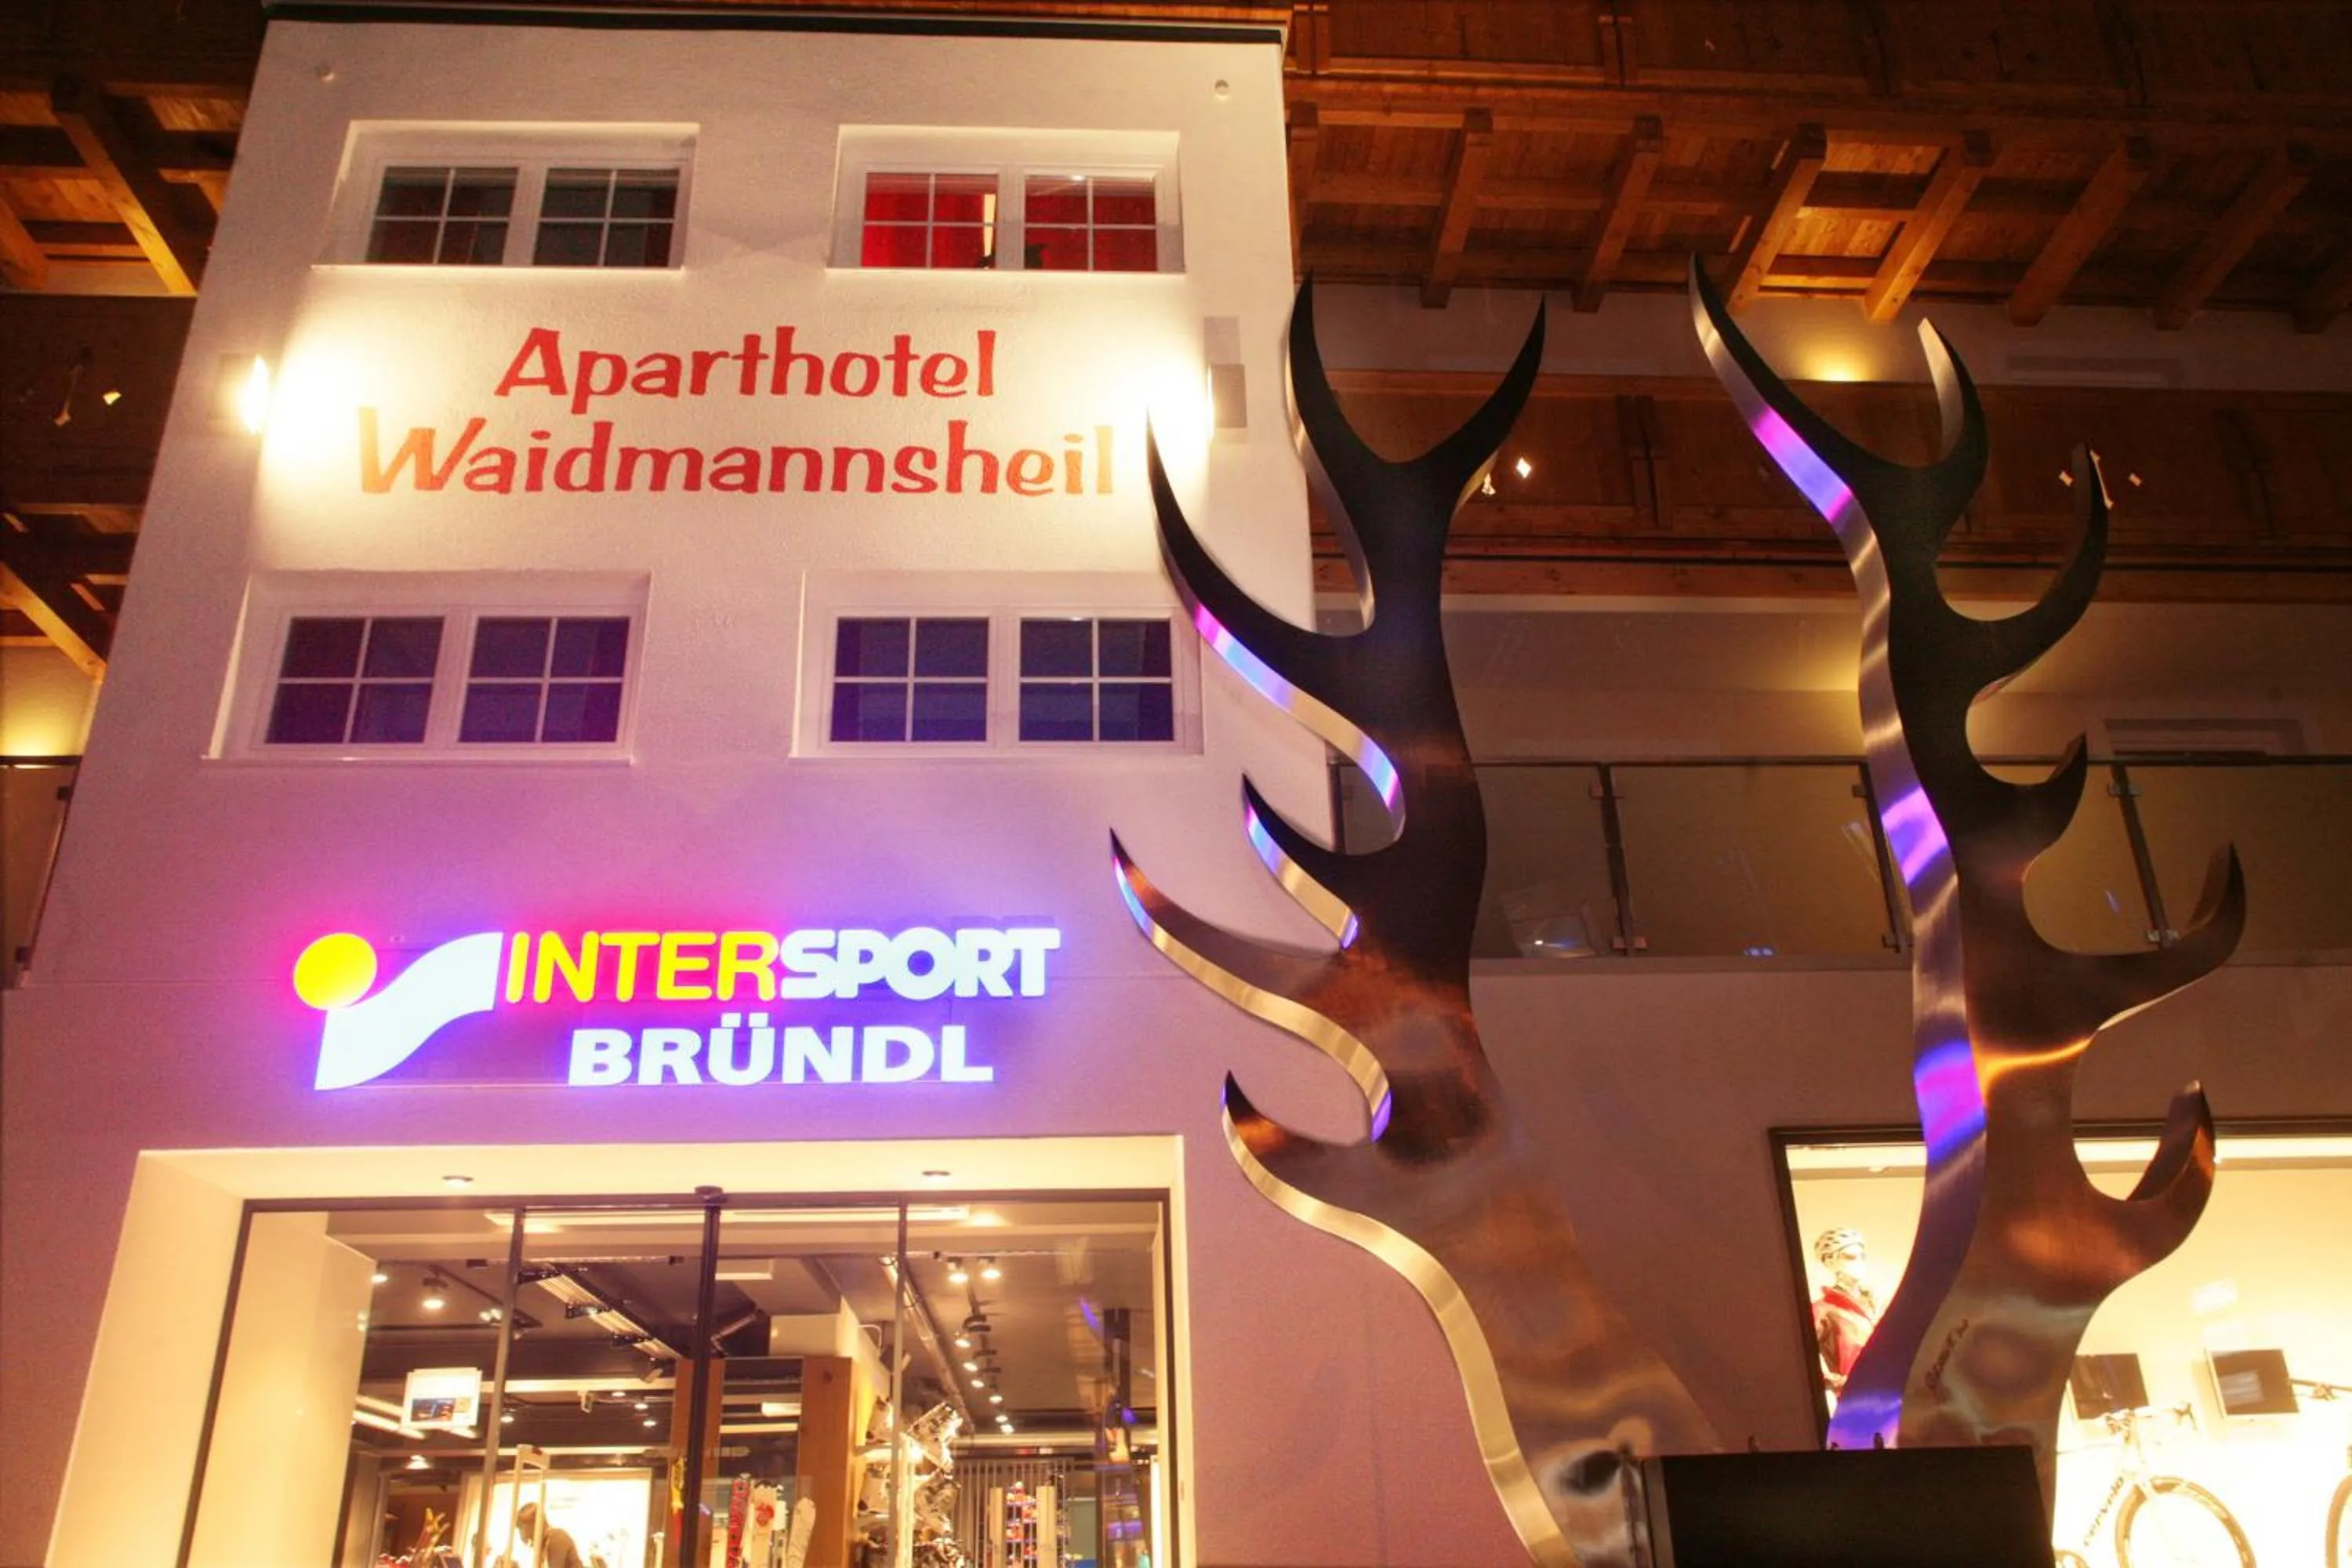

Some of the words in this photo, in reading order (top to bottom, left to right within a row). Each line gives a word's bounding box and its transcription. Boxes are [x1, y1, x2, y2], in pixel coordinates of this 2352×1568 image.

[494, 325, 996, 415] Aparthotel
[358, 406, 1113, 497] Waidmannsheil
[504, 926, 1061, 1003] INTERSPORT
[568, 1012, 994, 1087] BRÜNDL
